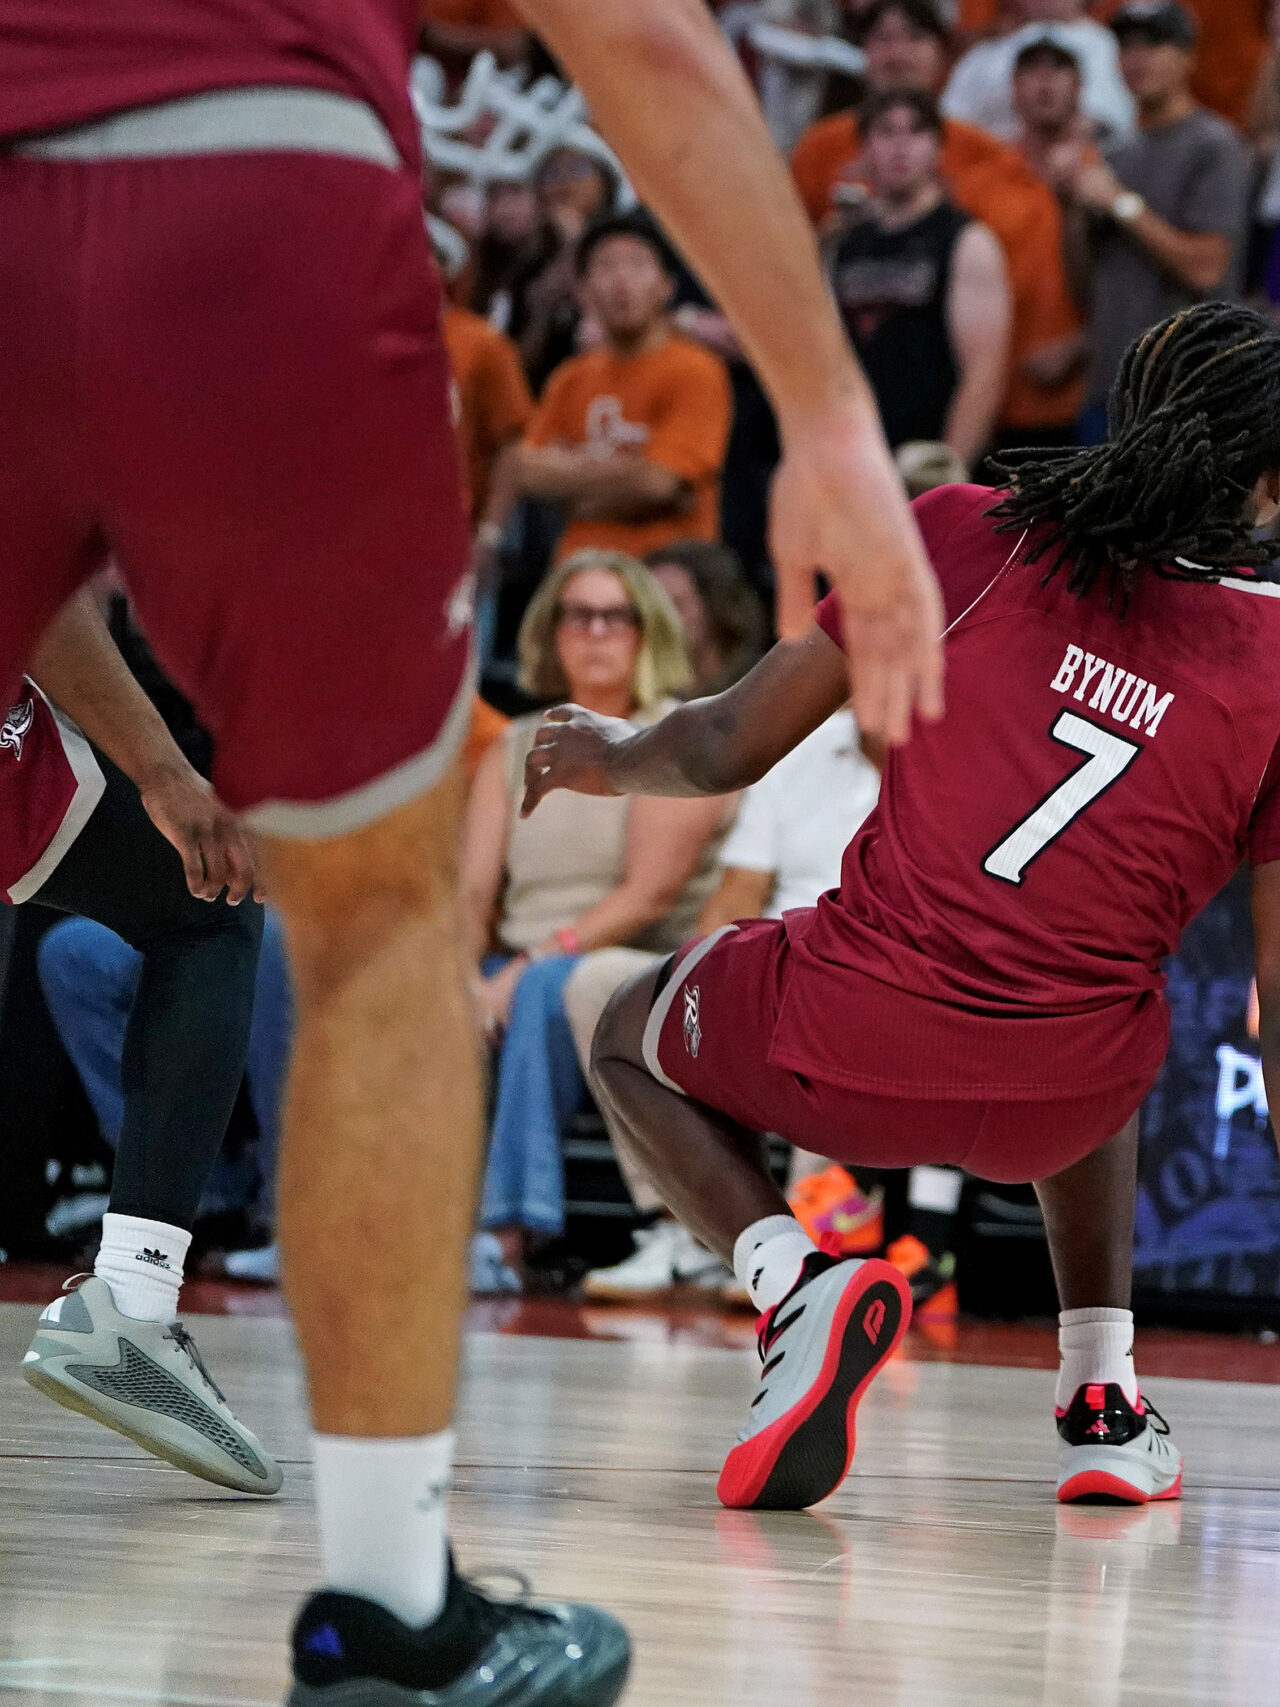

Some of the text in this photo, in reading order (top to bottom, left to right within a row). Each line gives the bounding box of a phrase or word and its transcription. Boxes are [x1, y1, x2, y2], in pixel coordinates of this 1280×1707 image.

[1050, 643, 1175, 738] BYNUM
[980, 706, 1144, 888] 7
[135, 1253, 171, 1269] adidas
